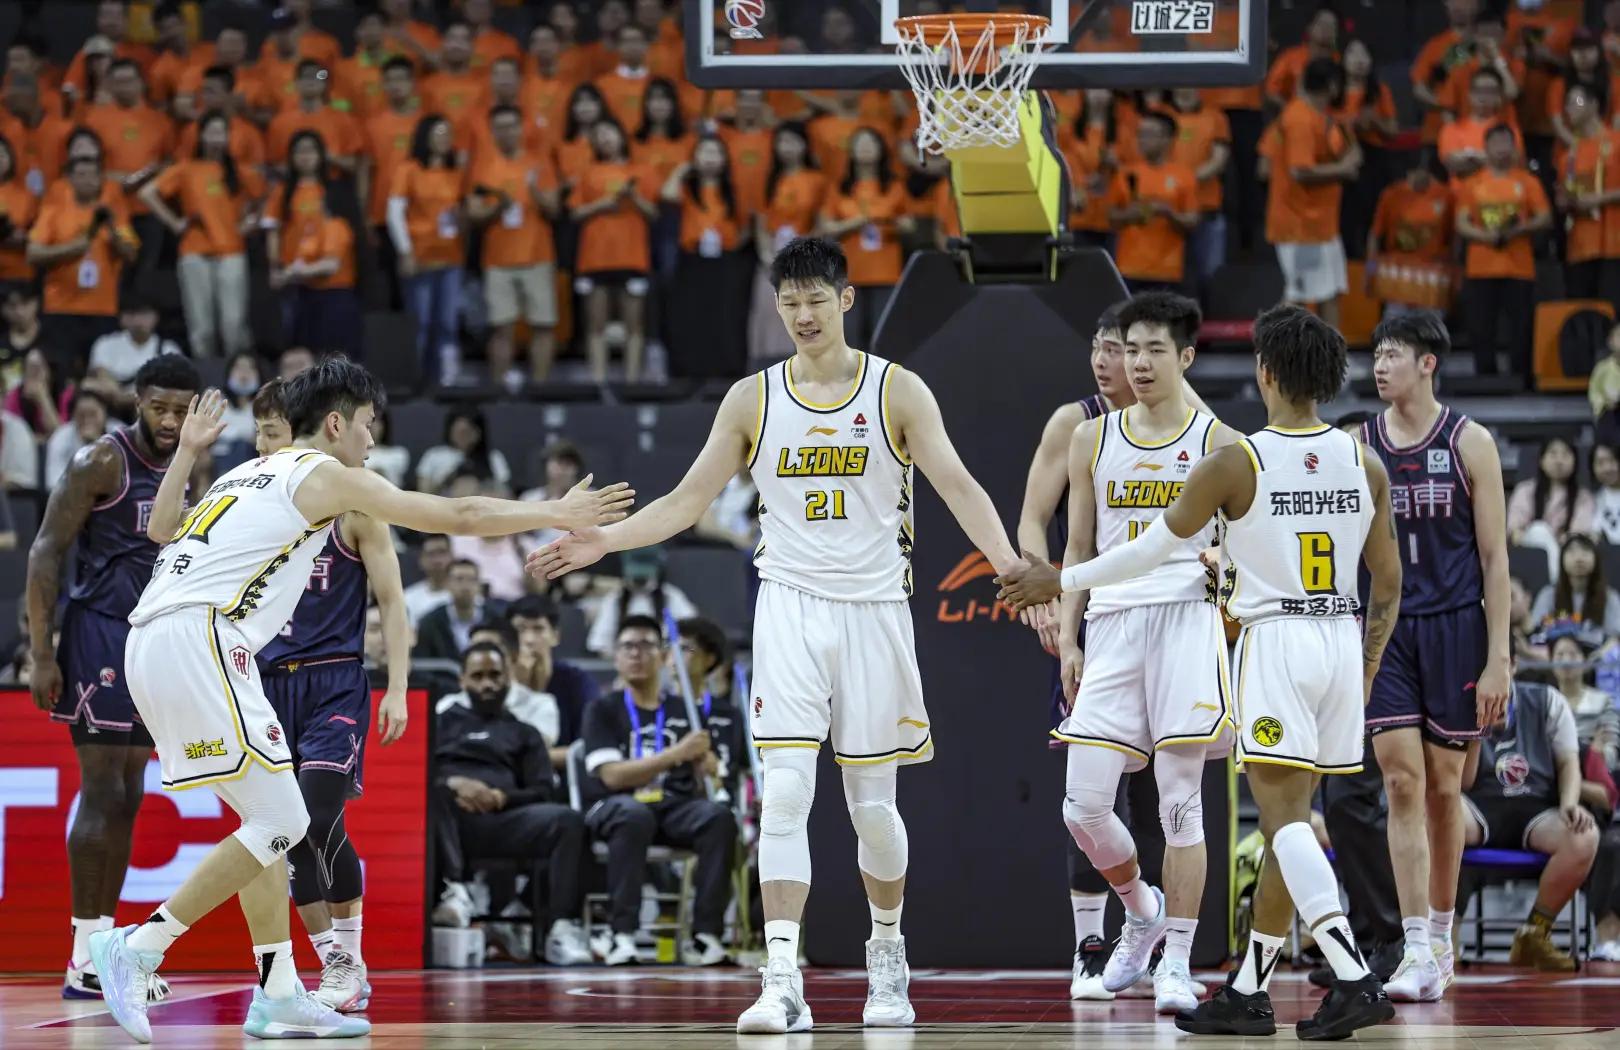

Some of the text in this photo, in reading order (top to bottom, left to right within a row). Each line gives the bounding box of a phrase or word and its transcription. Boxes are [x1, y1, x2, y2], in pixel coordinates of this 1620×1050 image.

[1134, 3, 1211, 30] 以城之名
[777, 446, 869, 477] LIONS
[805, 490, 848, 521] 21
[1270, 489, 1360, 516] 东阳光药
[1296, 532, 1339, 596] 6
